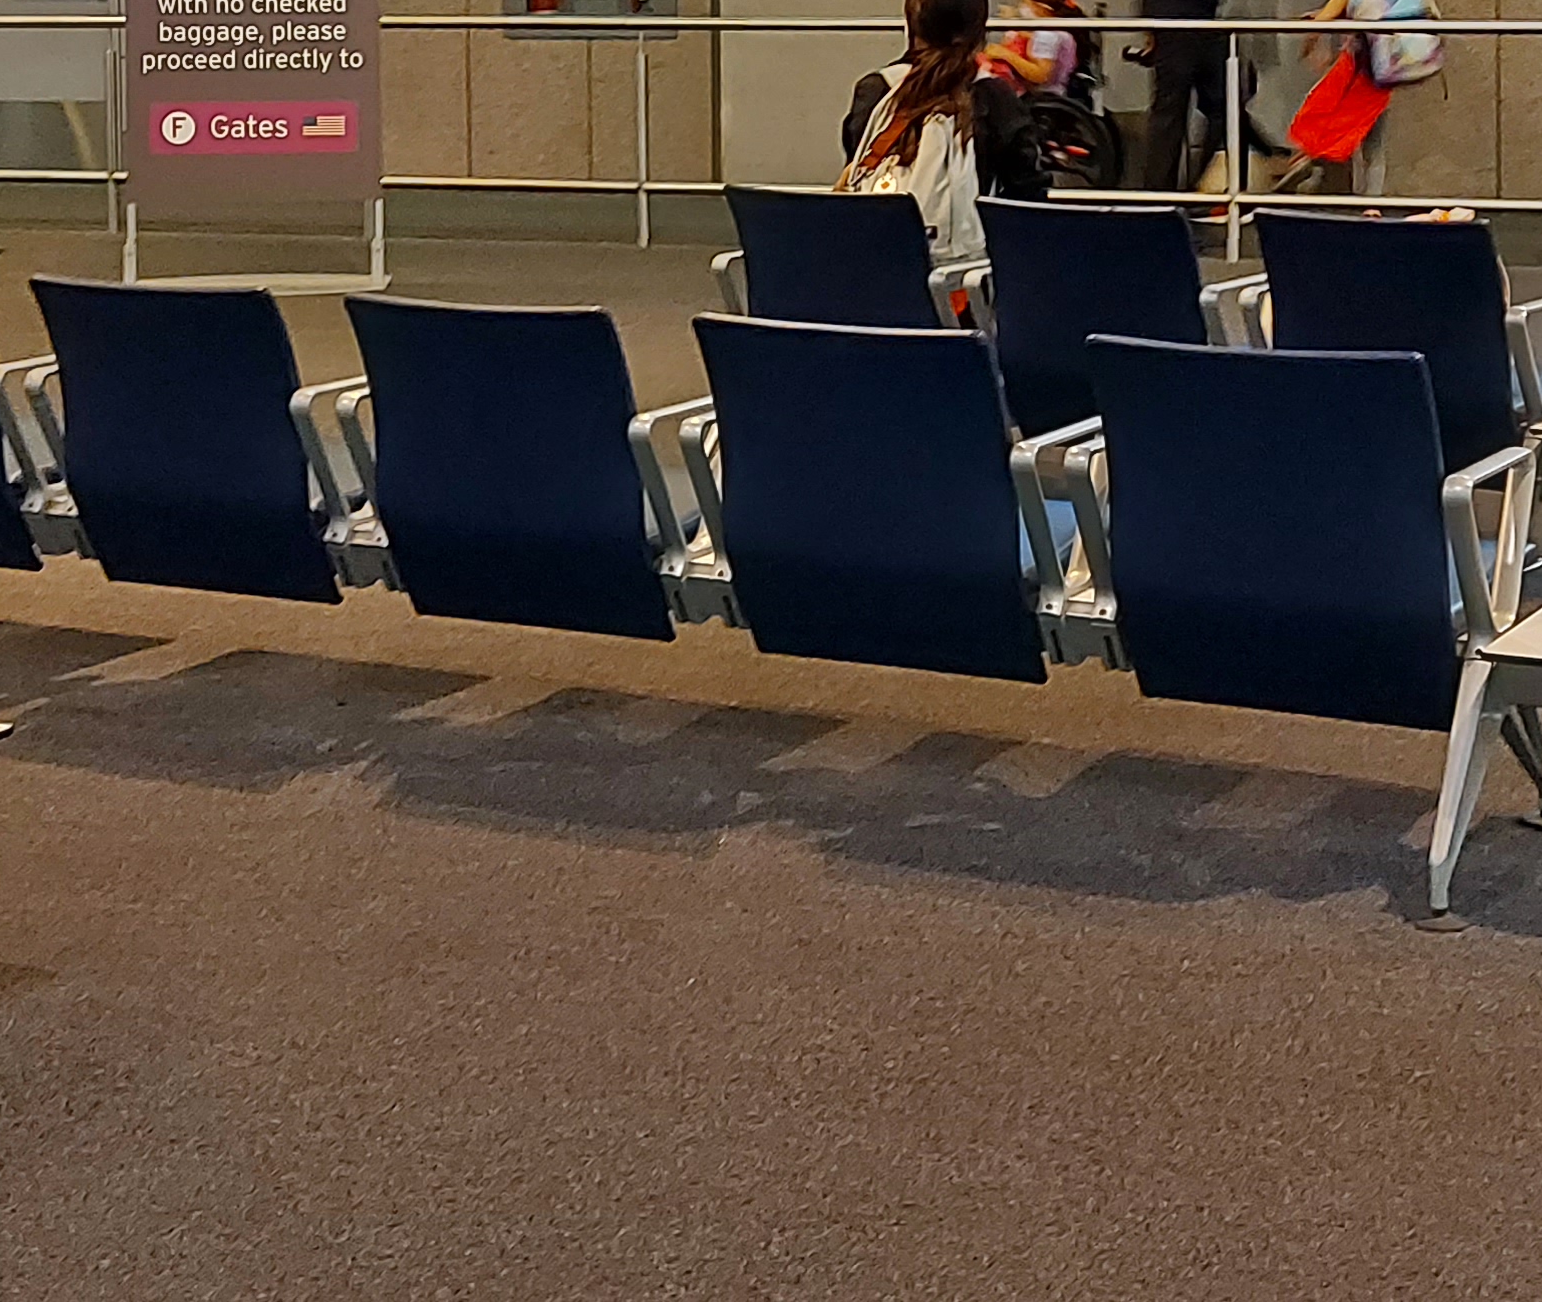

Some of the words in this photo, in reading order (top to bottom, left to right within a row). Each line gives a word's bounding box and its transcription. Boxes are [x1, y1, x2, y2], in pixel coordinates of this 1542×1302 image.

[159, 21, 264, 46] baggage,
[272, 20, 347, 45] please
[142, 49, 236, 74] proceed
[243, 48, 333, 73] directly
[339, 48, 364, 68] to
[210, 114, 288, 139] Gates
